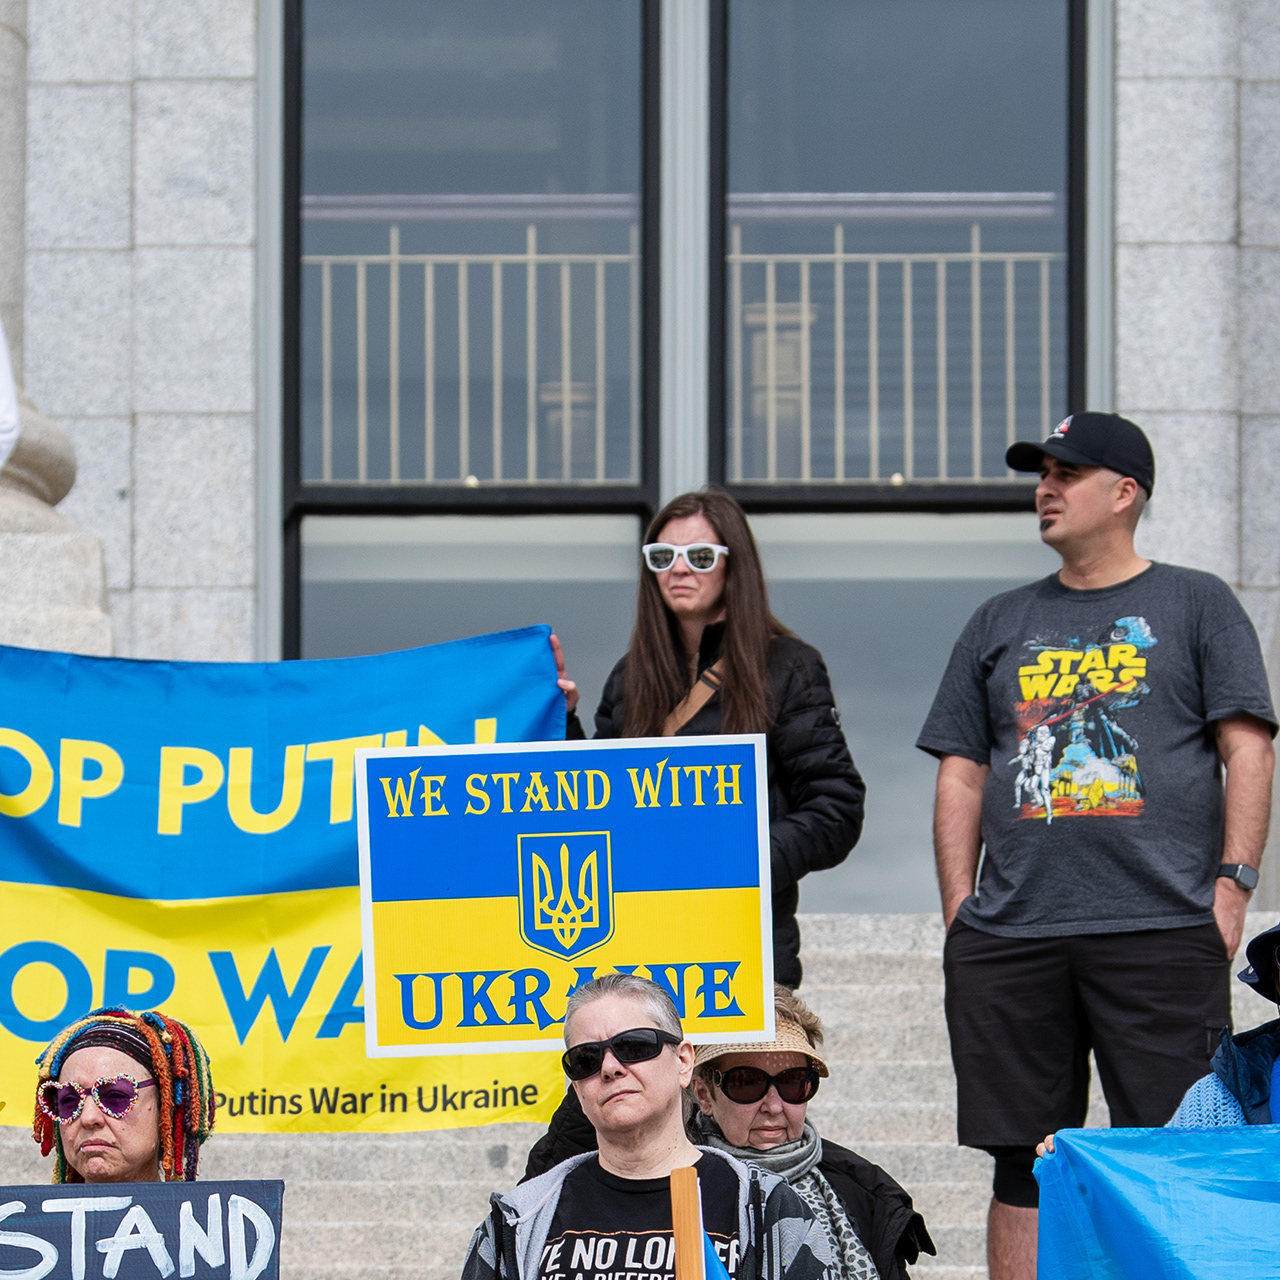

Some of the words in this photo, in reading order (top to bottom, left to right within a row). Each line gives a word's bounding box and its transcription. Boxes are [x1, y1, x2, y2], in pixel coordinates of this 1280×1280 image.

[1018, 644, 1147, 676] STAR
[1019, 667, 1147, 701] WARS
[157, 719, 497, 836] PUT
[379, 764, 450, 818] WE
[463, 769, 612, 816] STAND
[626, 755, 745, 809] WITH
[309, 1086, 374, 1115] War
[381, 1083, 408, 1113] in
[417, 1079, 539, 1113] Ukraine
[570, 1237, 619, 1271] NO
